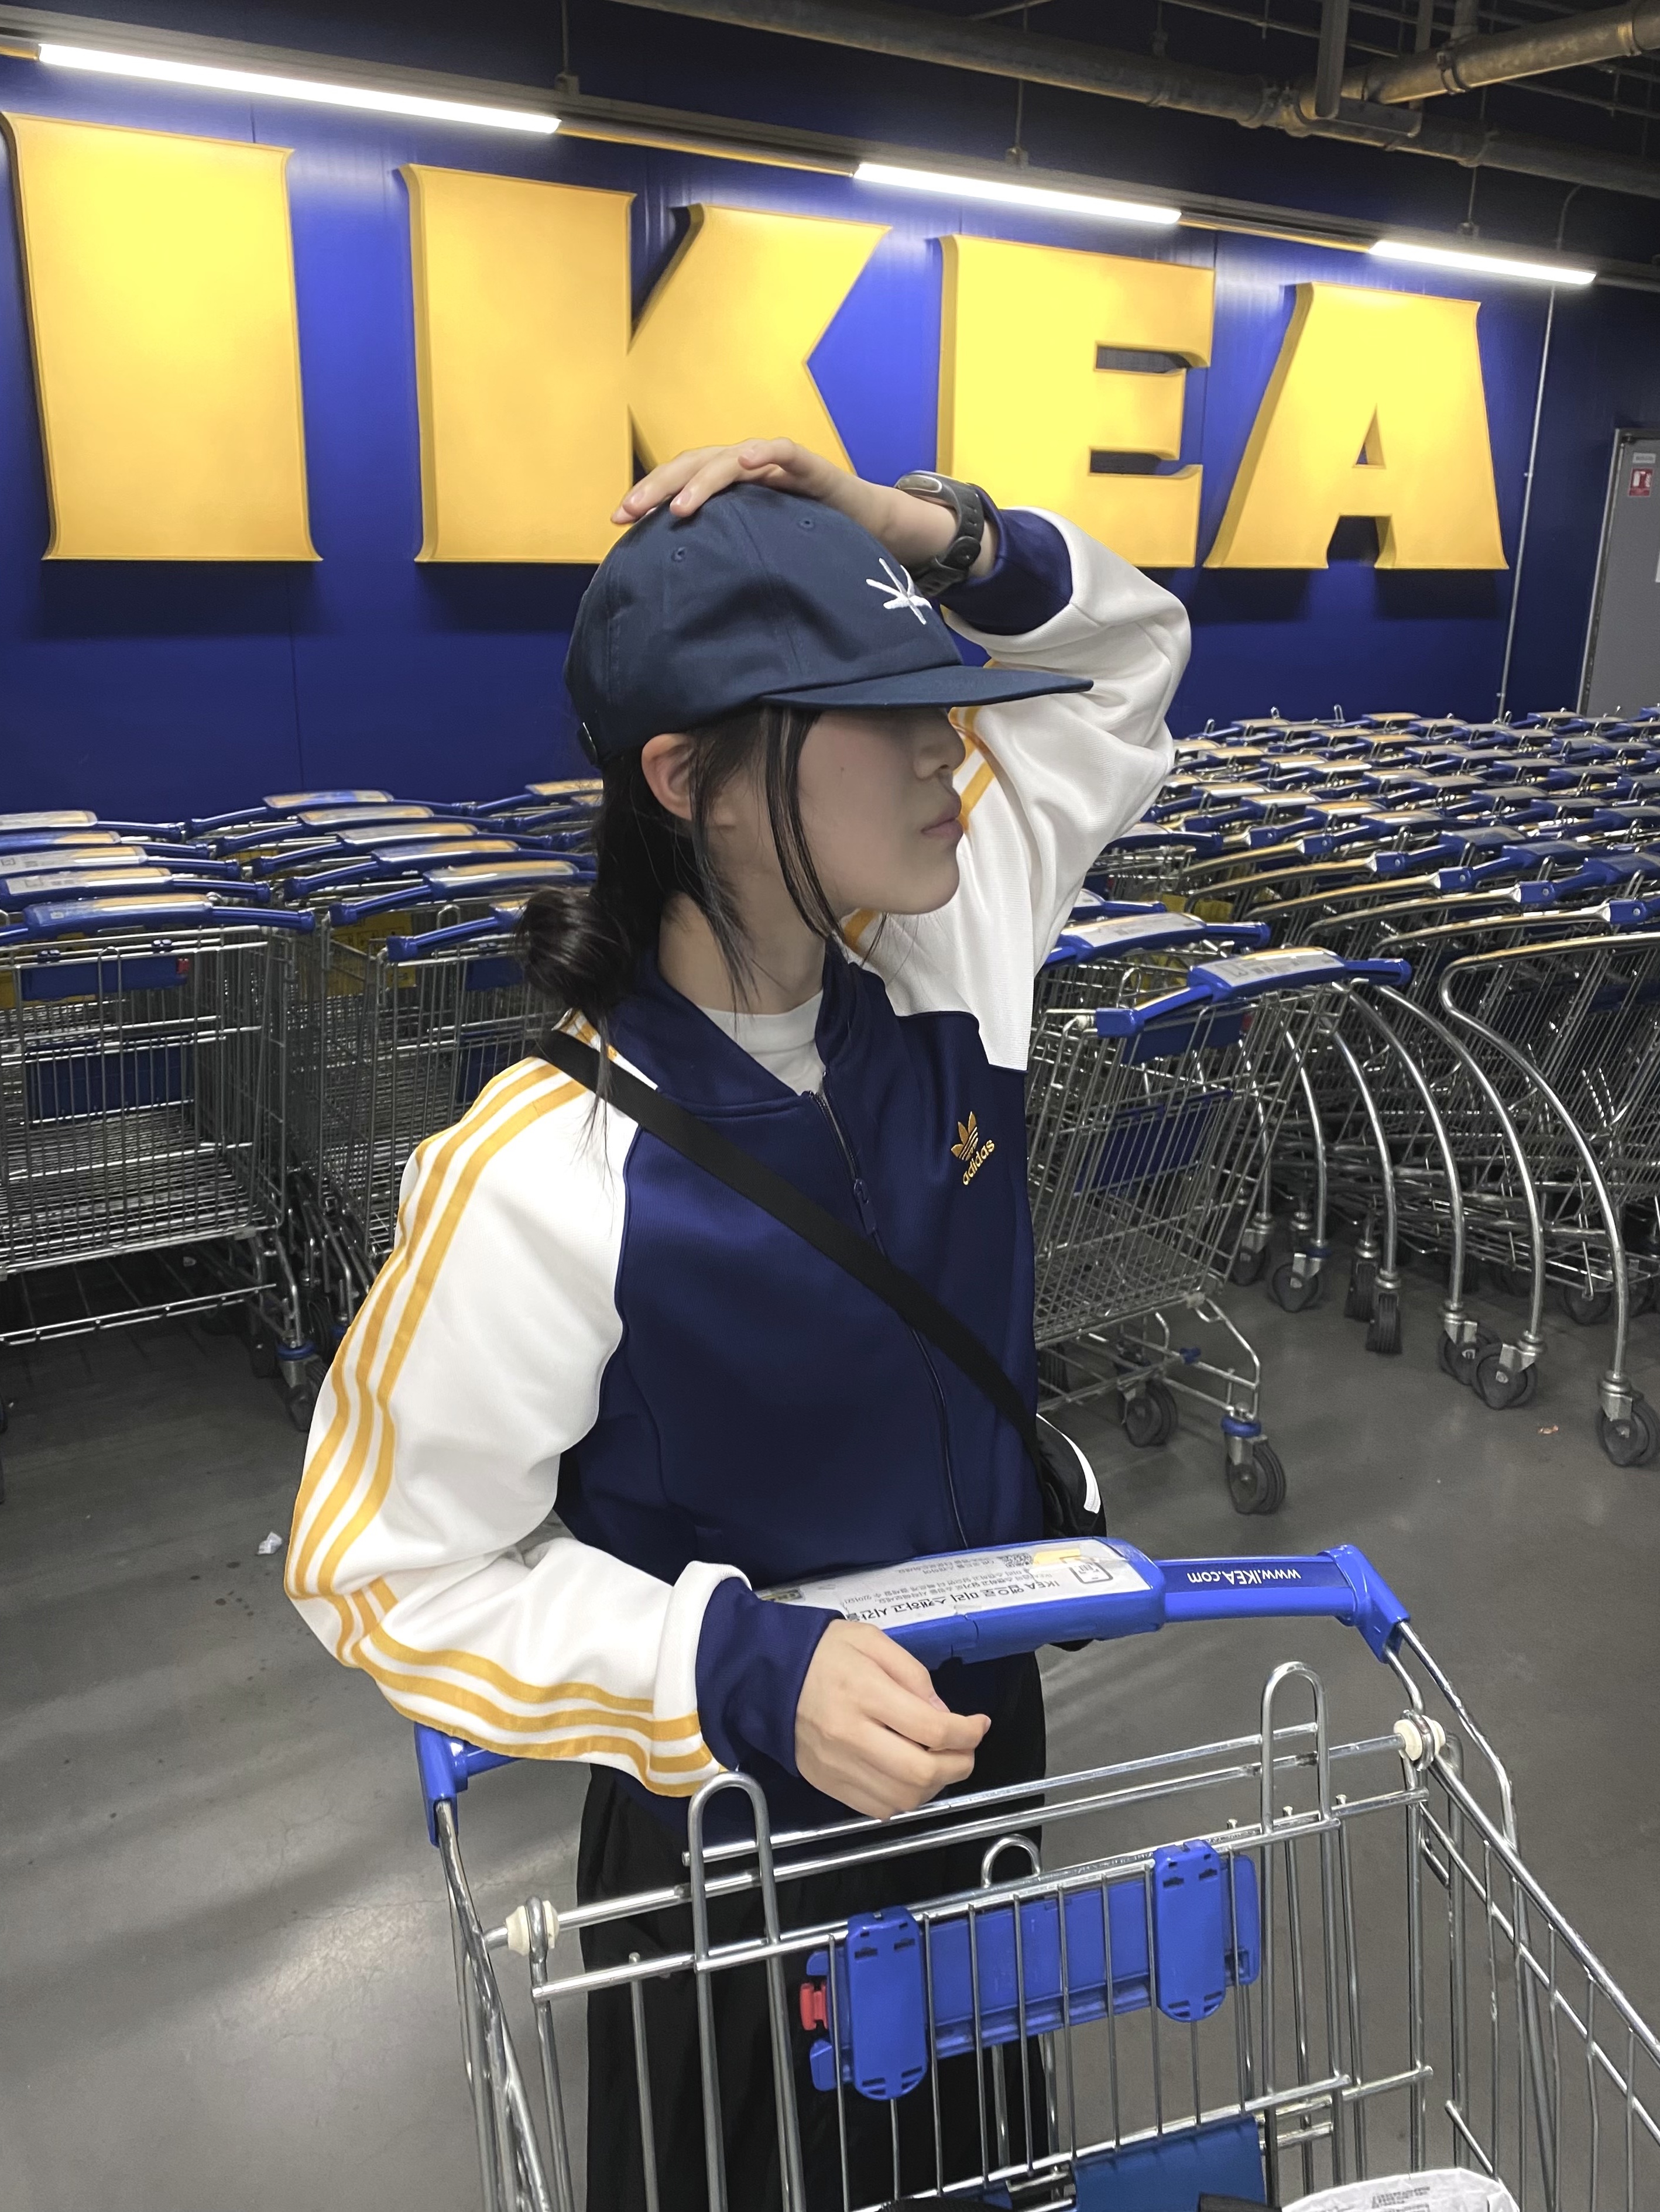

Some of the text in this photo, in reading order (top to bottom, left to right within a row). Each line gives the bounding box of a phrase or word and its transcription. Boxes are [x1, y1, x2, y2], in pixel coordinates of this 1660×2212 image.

[0, 111, 1509, 570] IKEA
[962, 1139, 995, 1186] adidas
[1024, 1580, 1060, 1589] IKEA
[1186, 1569, 1302, 1585] www.IKEA.com
[949, 1592, 980, 1603] 미리
[980, 1584, 1024, 1598] 앱으로
[891, 1596, 946, 1613] 스캔하고
